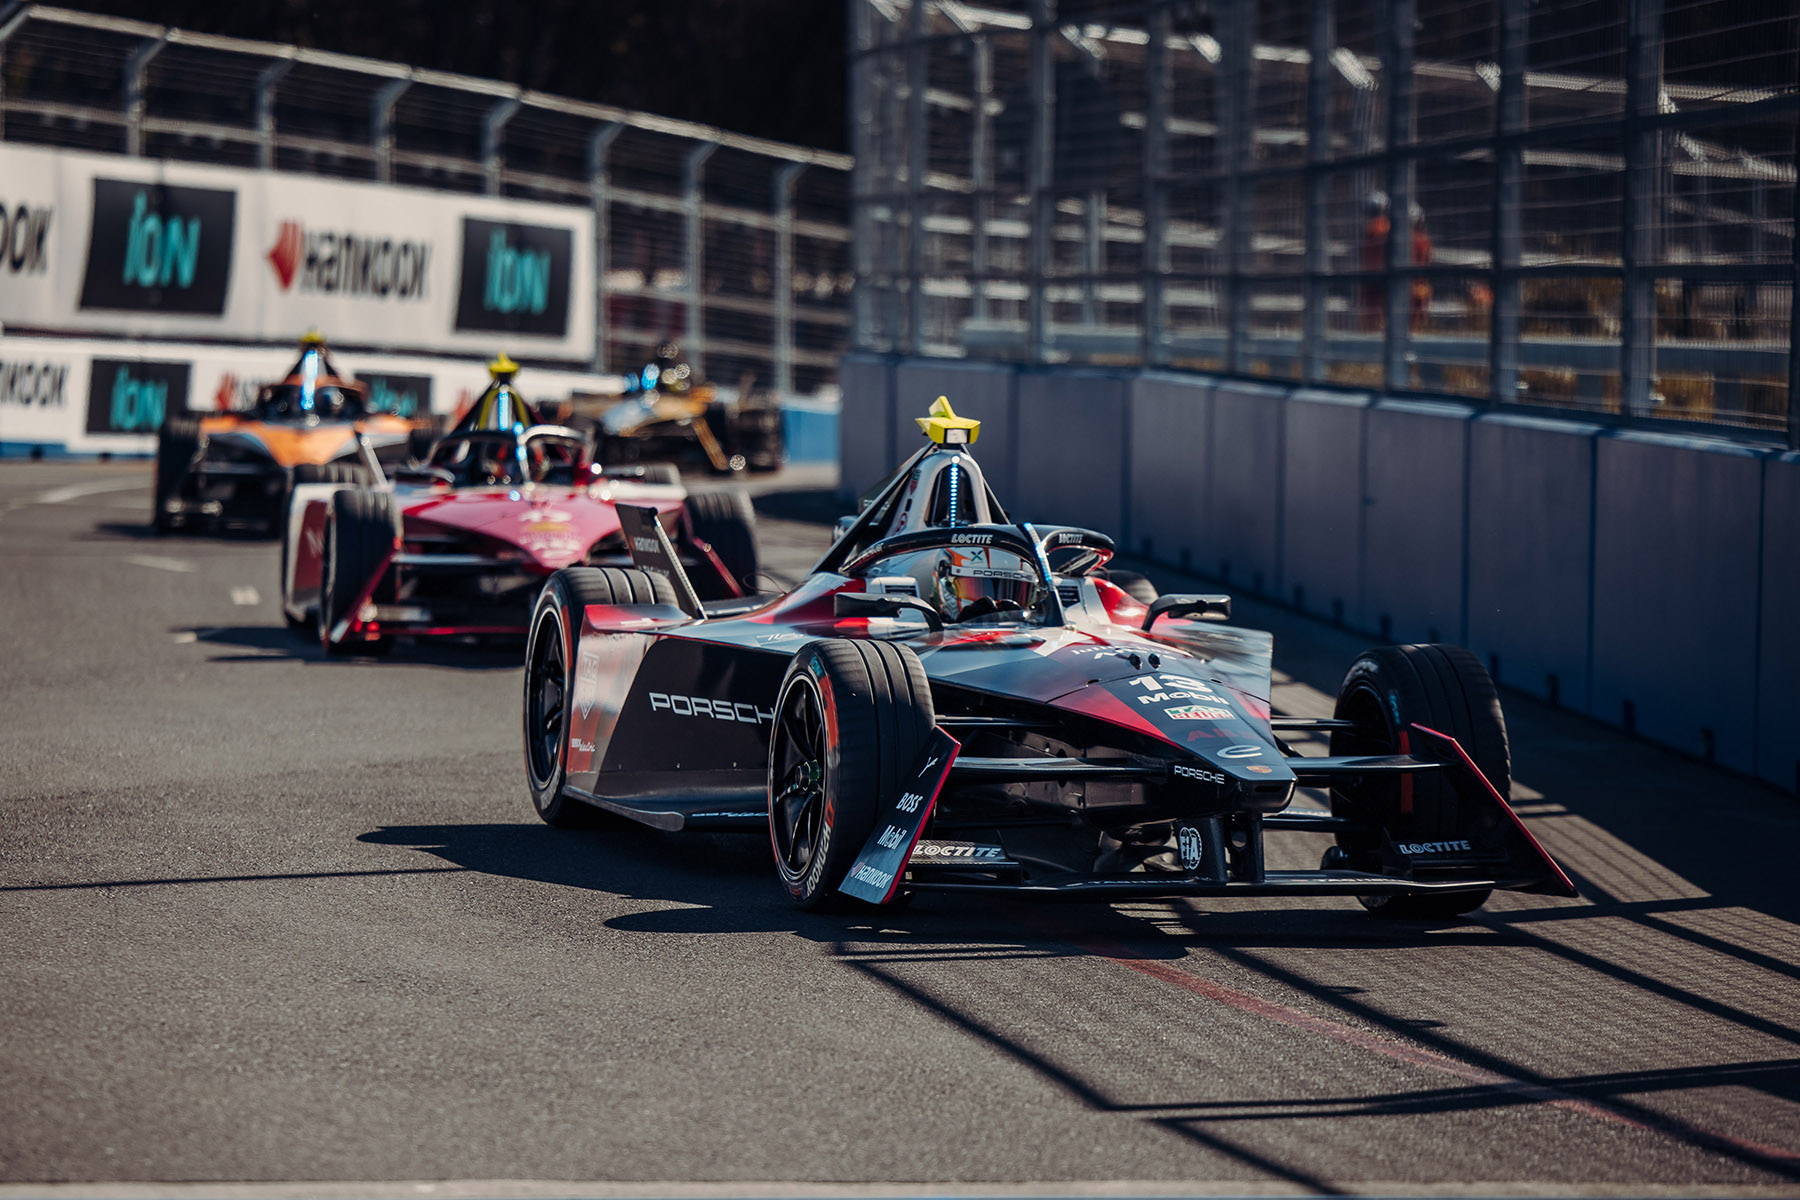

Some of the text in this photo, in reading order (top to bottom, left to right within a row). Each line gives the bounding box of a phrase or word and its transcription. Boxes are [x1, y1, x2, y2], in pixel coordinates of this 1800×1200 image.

[951, 533, 993, 545] LOCTITE
[973, 569, 1034, 581] PORSCHE
[1129, 675, 1213, 692] 13
[1137, 691, 1230, 705] Mobil
[648, 692, 777, 725] PORSCH
[1174, 765, 1225, 785] PORSCHE
[896, 792, 923, 813] BOSS
[913, 844, 1001, 857] LOCTITE
[1399, 840, 1471, 855] LOCTITE
